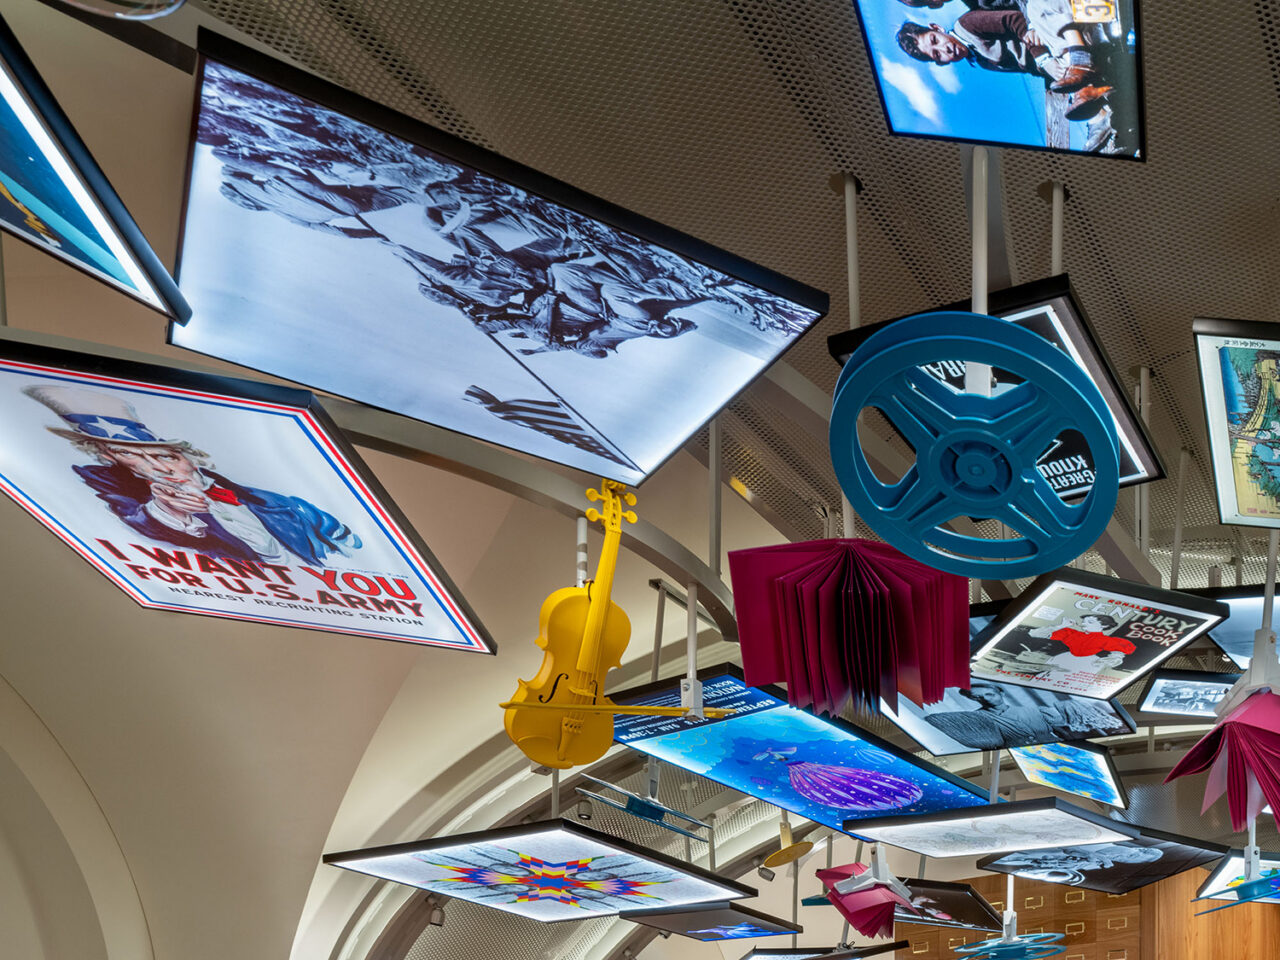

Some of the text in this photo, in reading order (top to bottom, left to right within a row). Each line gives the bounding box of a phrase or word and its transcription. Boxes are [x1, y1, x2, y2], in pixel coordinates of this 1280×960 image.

[95, 538, 131, 561] I
[128, 543, 296, 586] WANT
[298, 565, 417, 601] YOU
[124, 563, 424, 617] FOR U.S. ARMY
[1074, 591, 1160, 615] MARY RONALD'S
[168, 586, 424, 627] NEAREST RECRUITING STATION
[1074, 599, 1198, 630] CENTURY
[996, 668, 1011, 677] THE
[1014, 672, 1052, 683] CENTURY
[662, 723, 681, 732] 9AM
